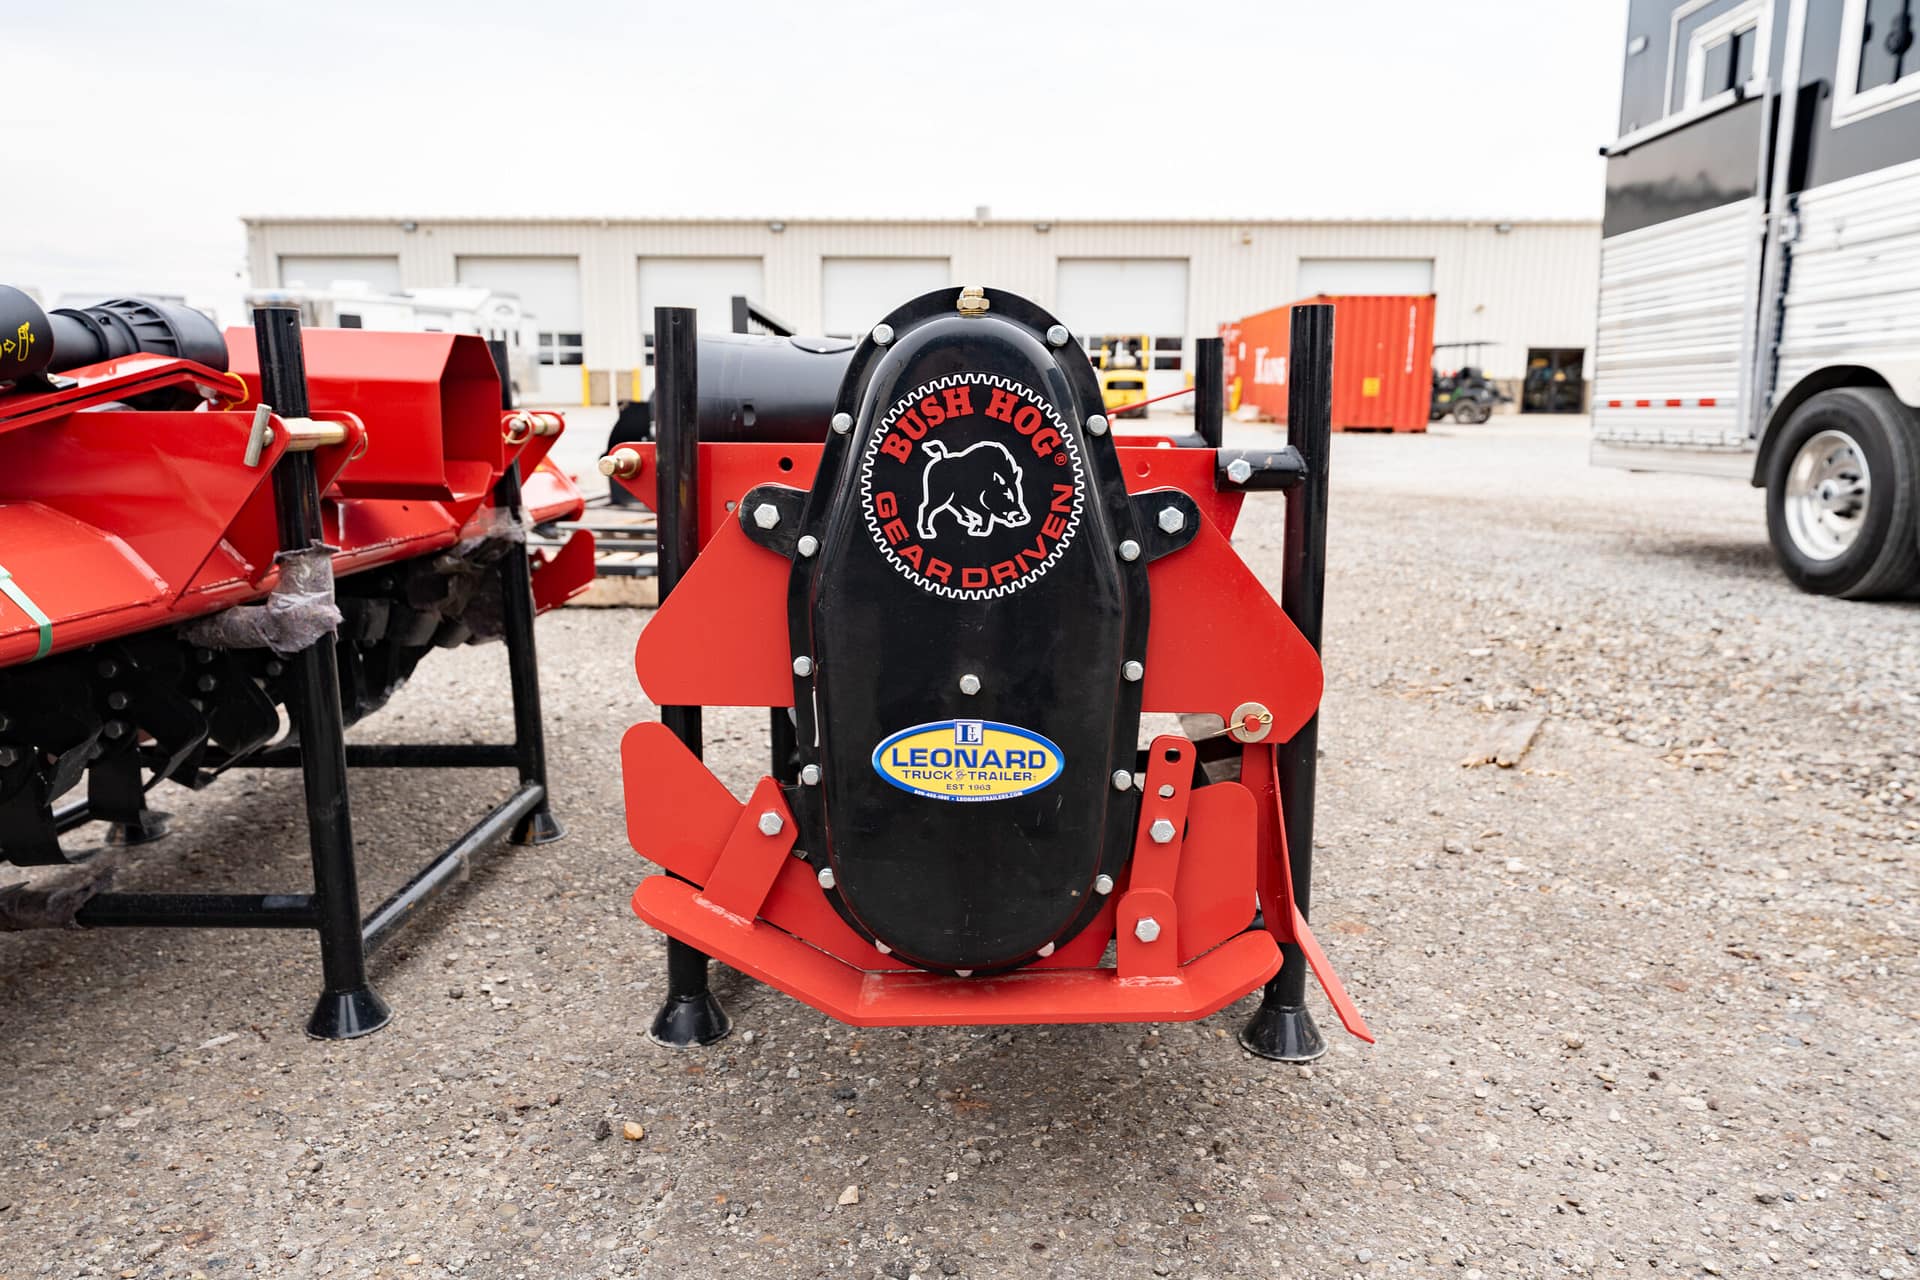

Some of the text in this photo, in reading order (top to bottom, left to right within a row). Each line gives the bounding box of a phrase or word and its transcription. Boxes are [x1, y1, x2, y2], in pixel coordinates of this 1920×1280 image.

[880, 386, 974, 464] BUSH
[875, 483, 1074, 588] GEAR DRIVEN
[892, 747, 1046, 769] LEONARD
[902, 770, 953, 780] TRUCK
[967, 771, 1032, 781] TRAILER
